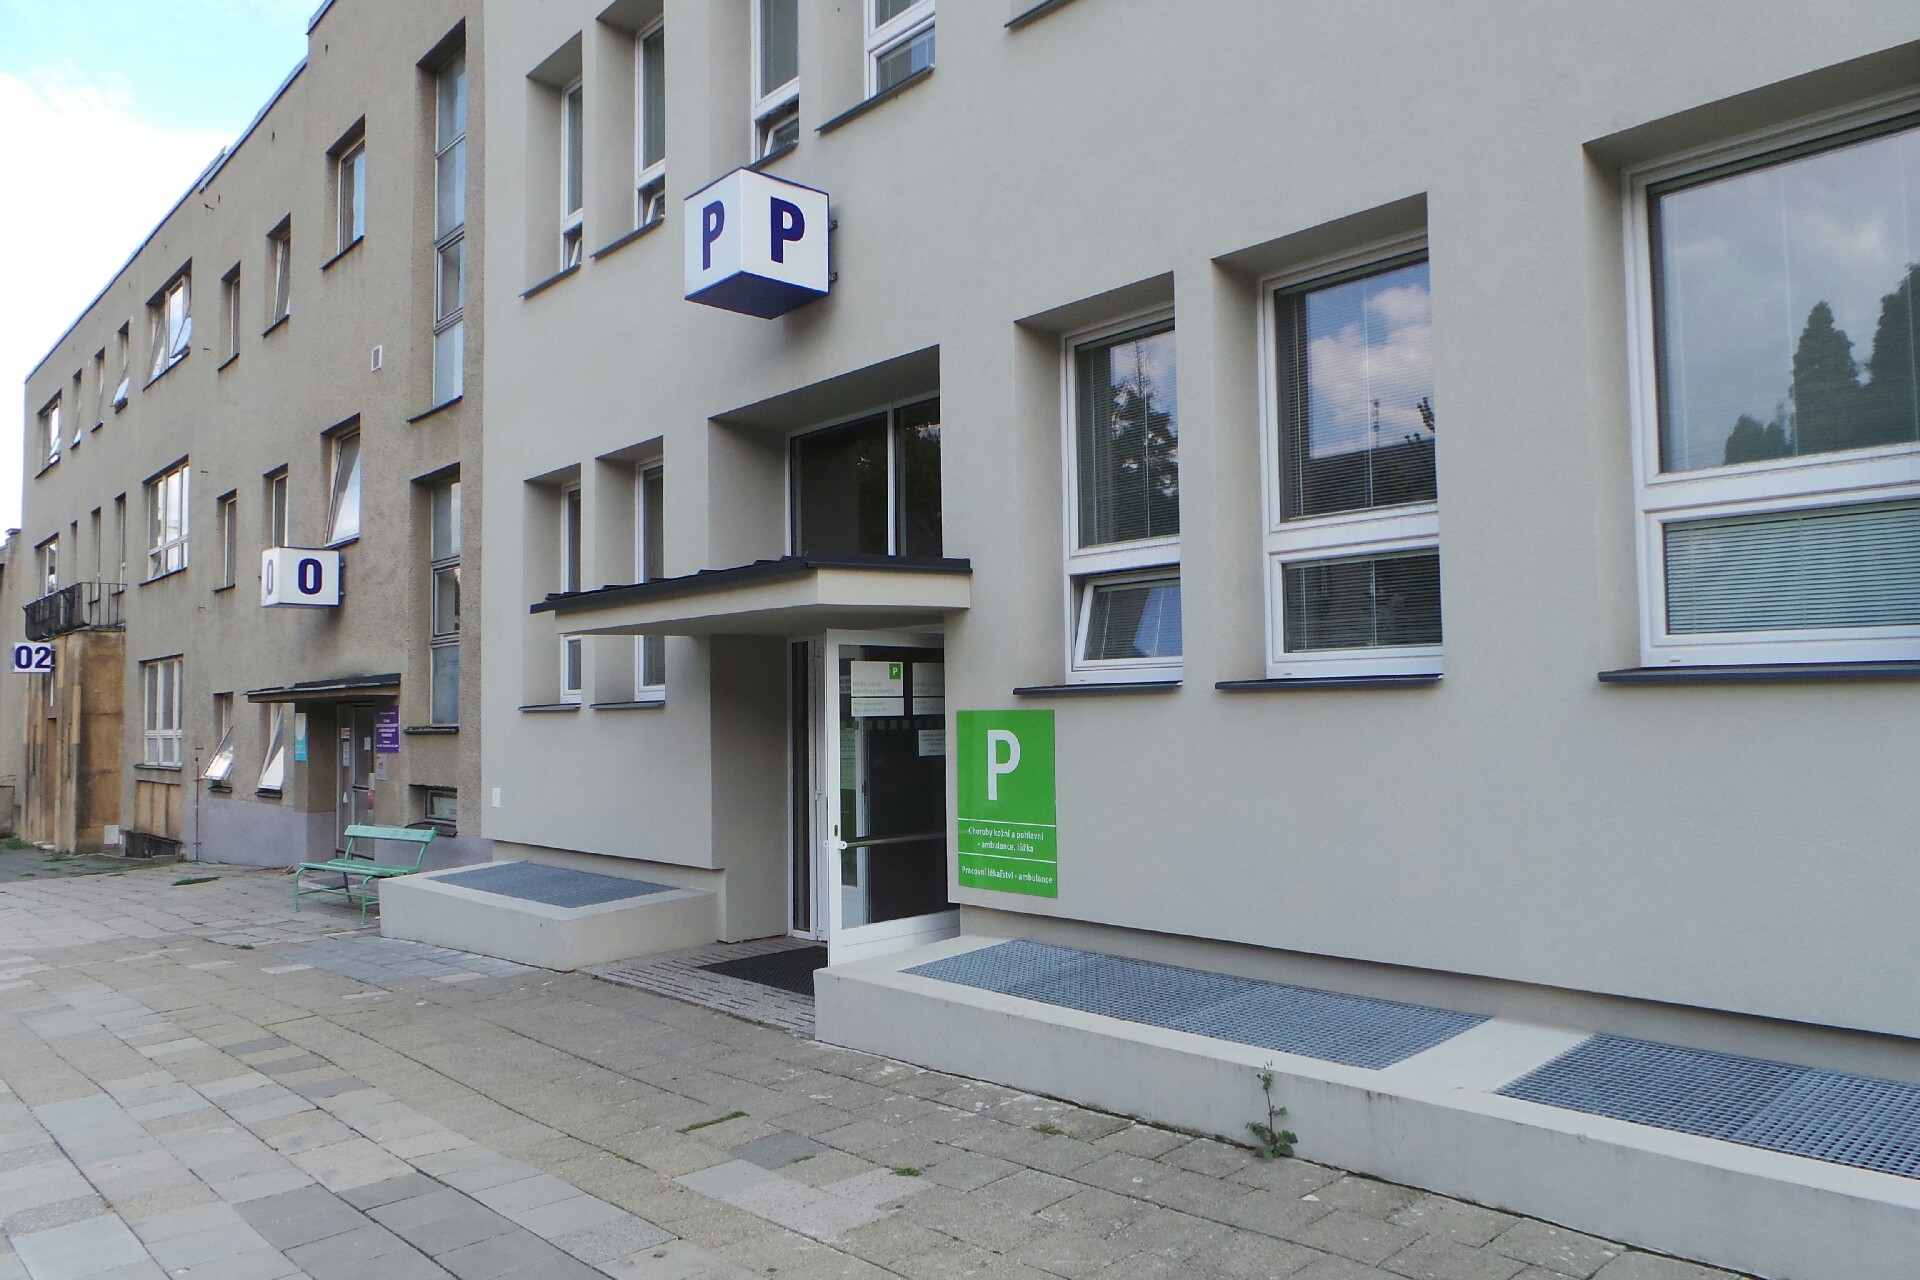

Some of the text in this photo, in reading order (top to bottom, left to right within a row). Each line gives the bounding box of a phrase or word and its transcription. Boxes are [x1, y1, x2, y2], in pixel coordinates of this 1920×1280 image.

[702, 200, 725, 271] P
[770, 196, 806, 264] P
[892, 666, 898, 676] P
[987, 729, 1021, 801] P
[968, 826, 993, 838] Choroby
[993, 828, 1011, 837] kožní
[981, 840, 1016, 852] ambulance,
[961, 865, 987, 876] Pracovní
[1018, 873, 1053, 884] ambulance
